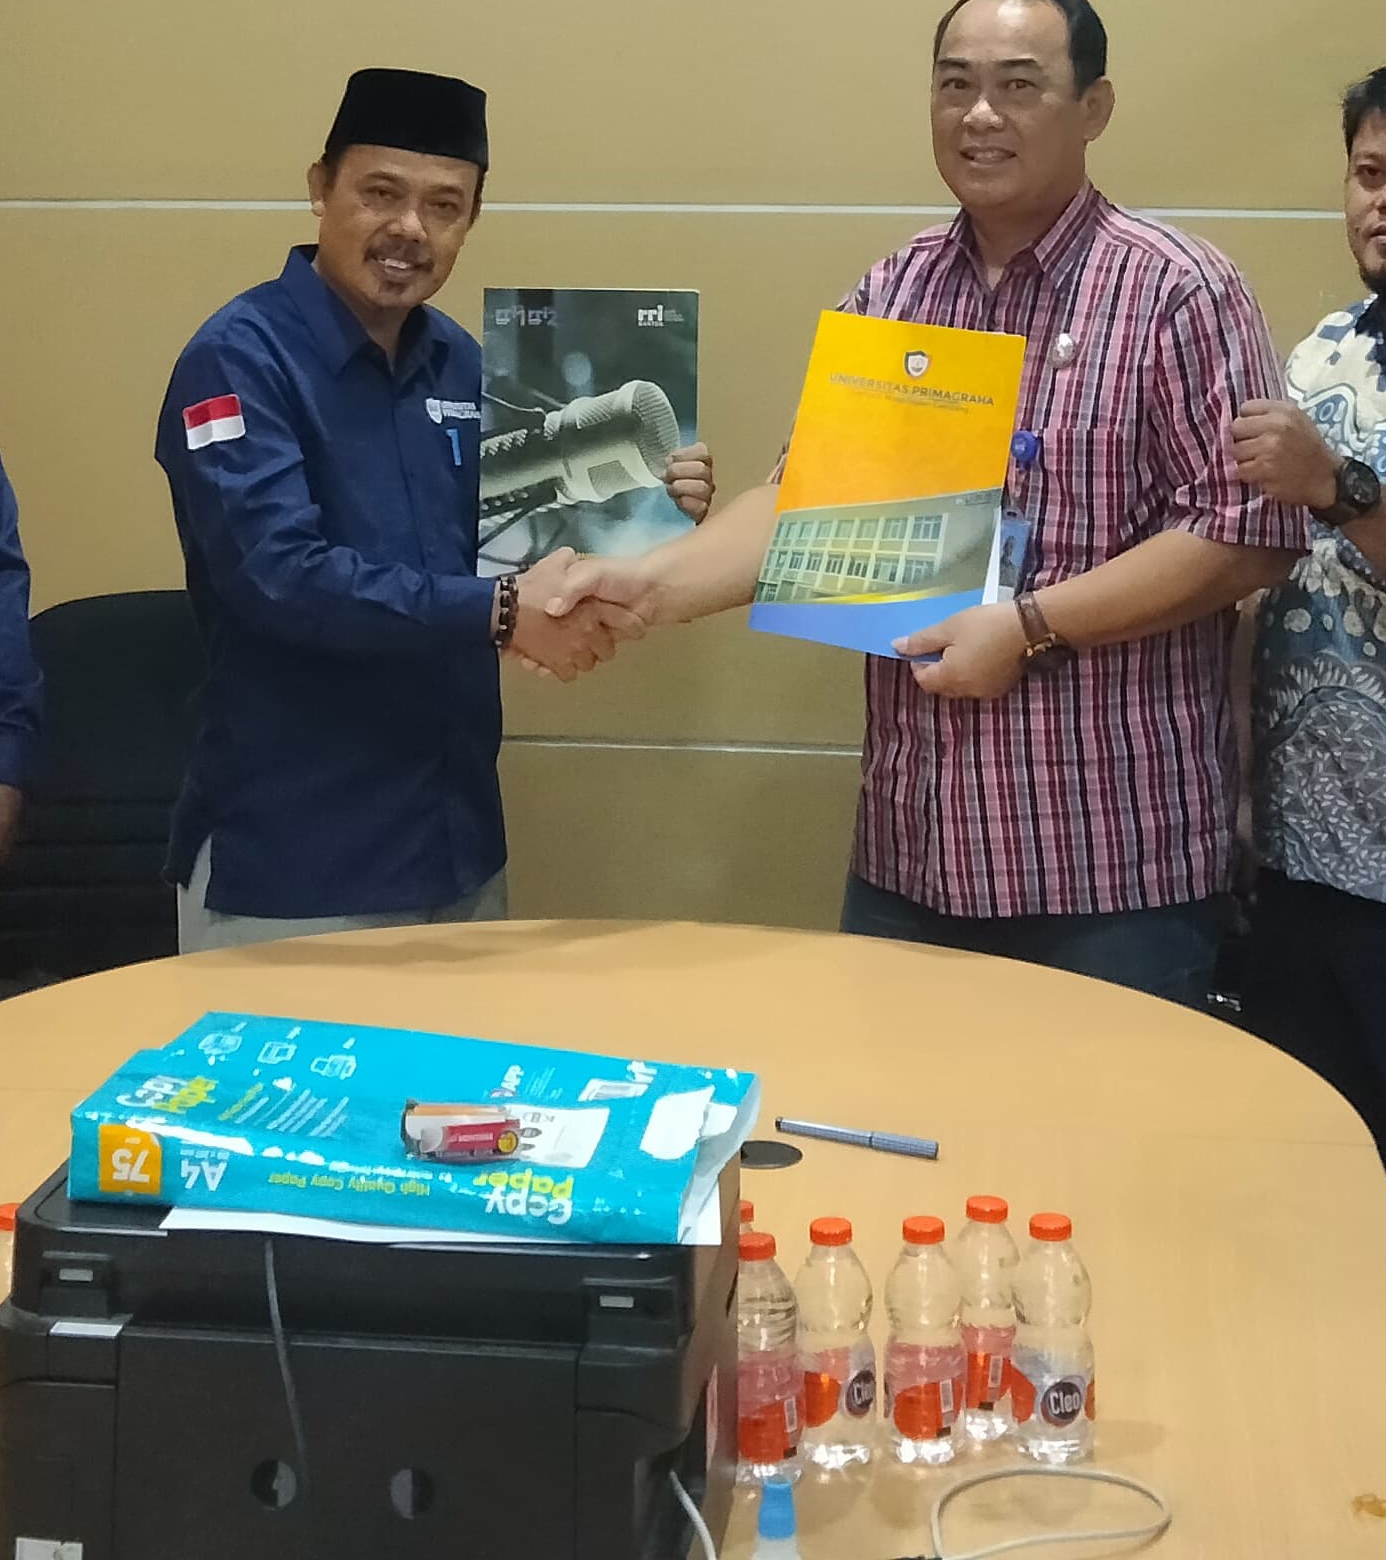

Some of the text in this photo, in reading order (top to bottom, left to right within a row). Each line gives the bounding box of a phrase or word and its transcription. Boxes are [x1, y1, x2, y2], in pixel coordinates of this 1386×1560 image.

[829, 372, 908, 394] UNIVERSITAS
[912, 386, 994, 406] PRIMAGRAHA
[111, 1148, 150, 1183] 75
[180, 1159, 227, 1191] A4
[400, 1179, 430, 1196] High
[473, 1167, 574, 1200] Paper
[1049, 1390, 1079, 1415] Cleo
